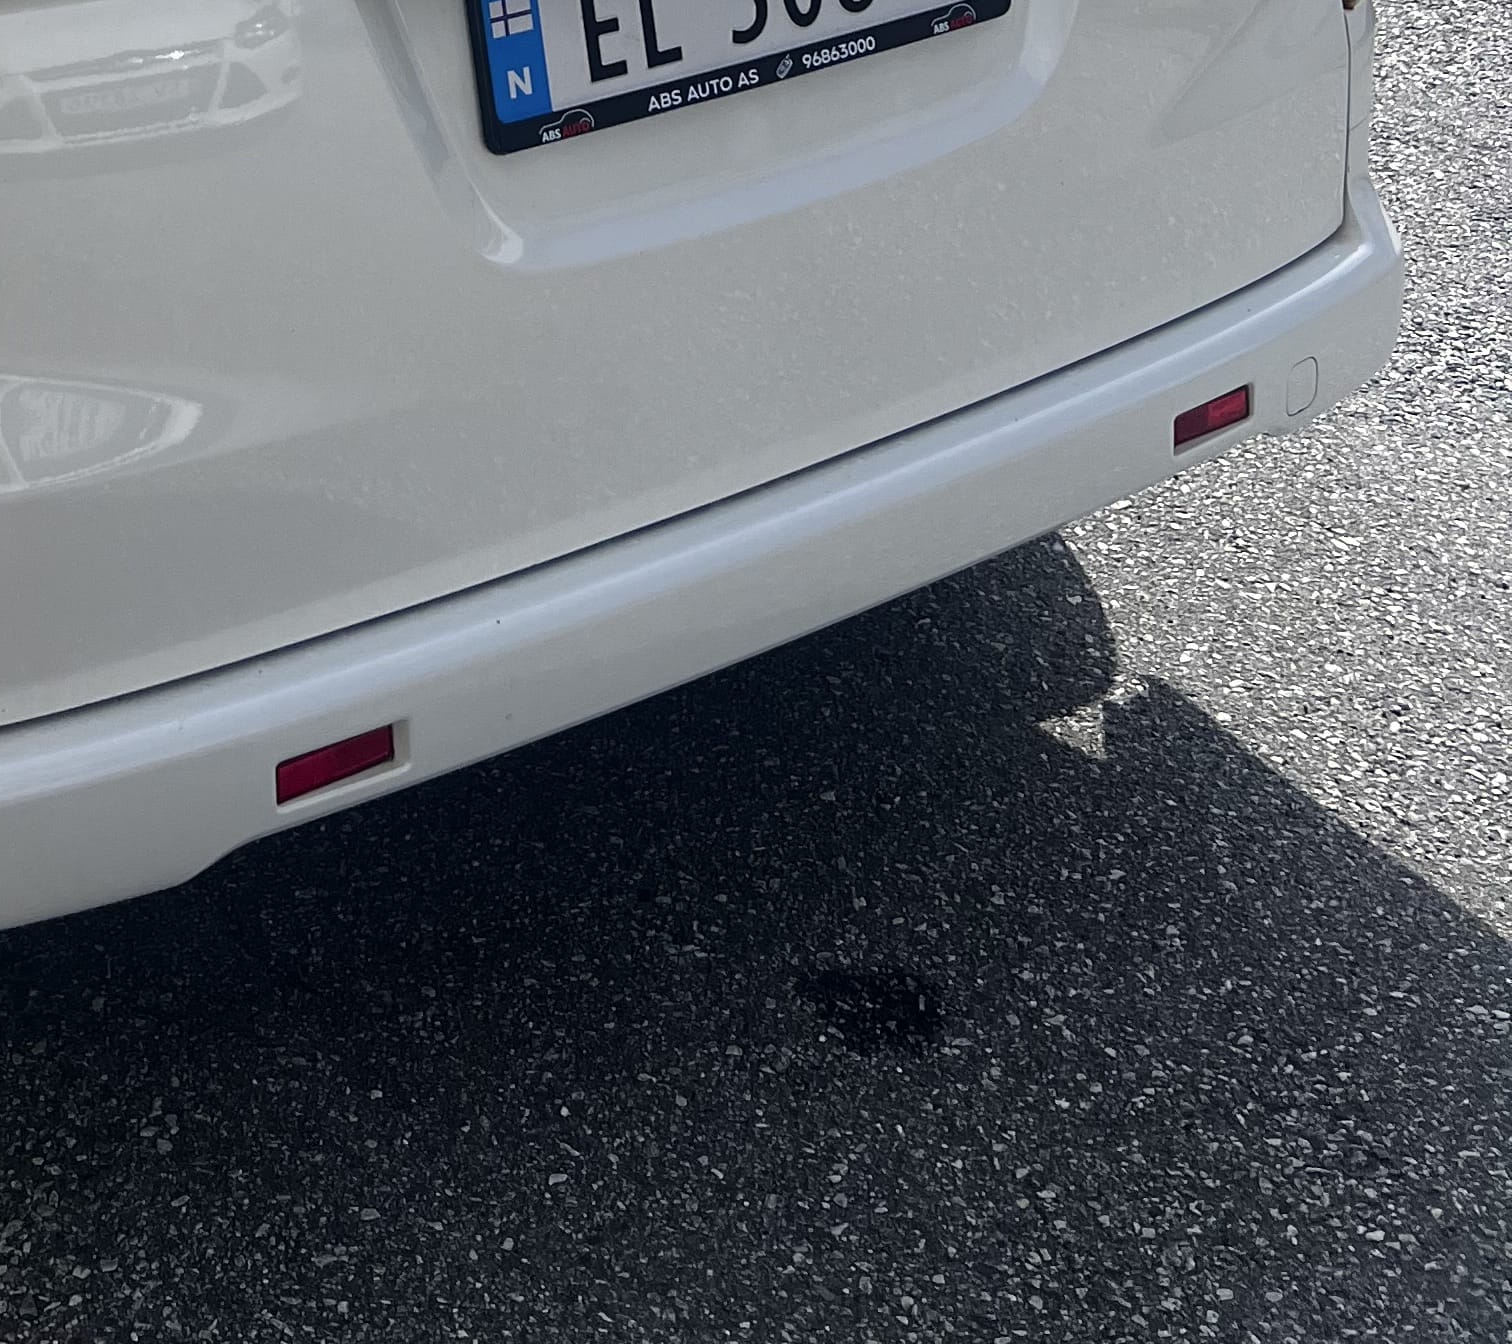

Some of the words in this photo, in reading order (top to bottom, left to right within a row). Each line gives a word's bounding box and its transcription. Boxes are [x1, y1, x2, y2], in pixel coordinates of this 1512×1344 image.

[932, 21, 950, 35] ABS
[506, 66, 533, 100] N
[647, 89, 683, 112] ABS
[687, 77, 733, 102] AUTO
[737, 68, 760, 88] AS
[801, 36, 876, 68] 96863000
[541, 128, 562, 144] ABS
